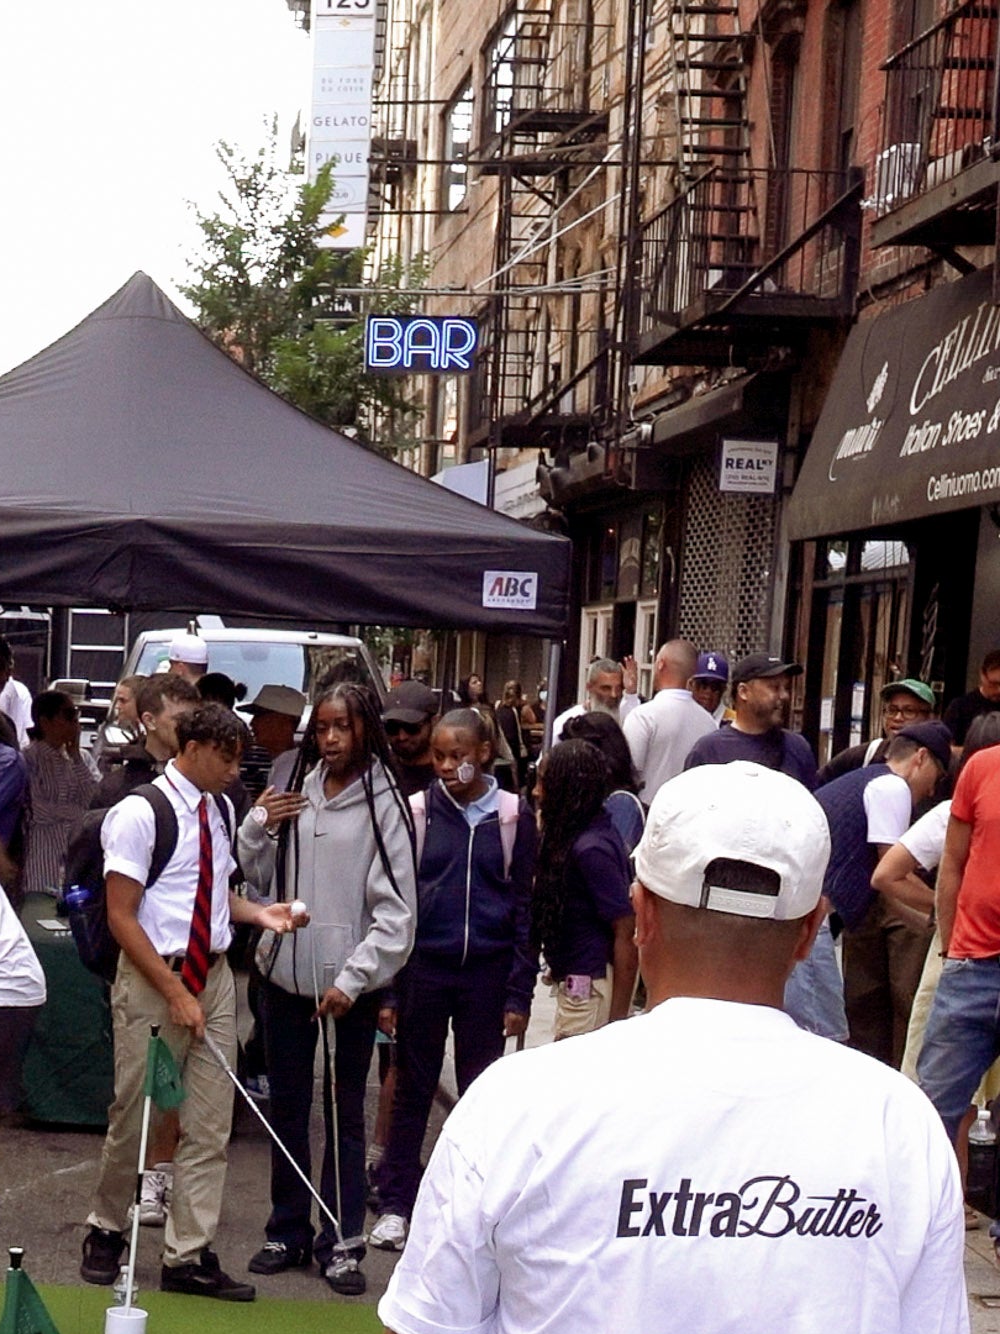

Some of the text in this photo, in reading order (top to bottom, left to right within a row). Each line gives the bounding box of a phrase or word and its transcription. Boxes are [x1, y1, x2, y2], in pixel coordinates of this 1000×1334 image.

[313, 116, 368, 127] GELATO
[368, 317, 476, 369] BAR
[942, 409, 987, 446] Shoes
[489, 576, 533, 598] ABC
